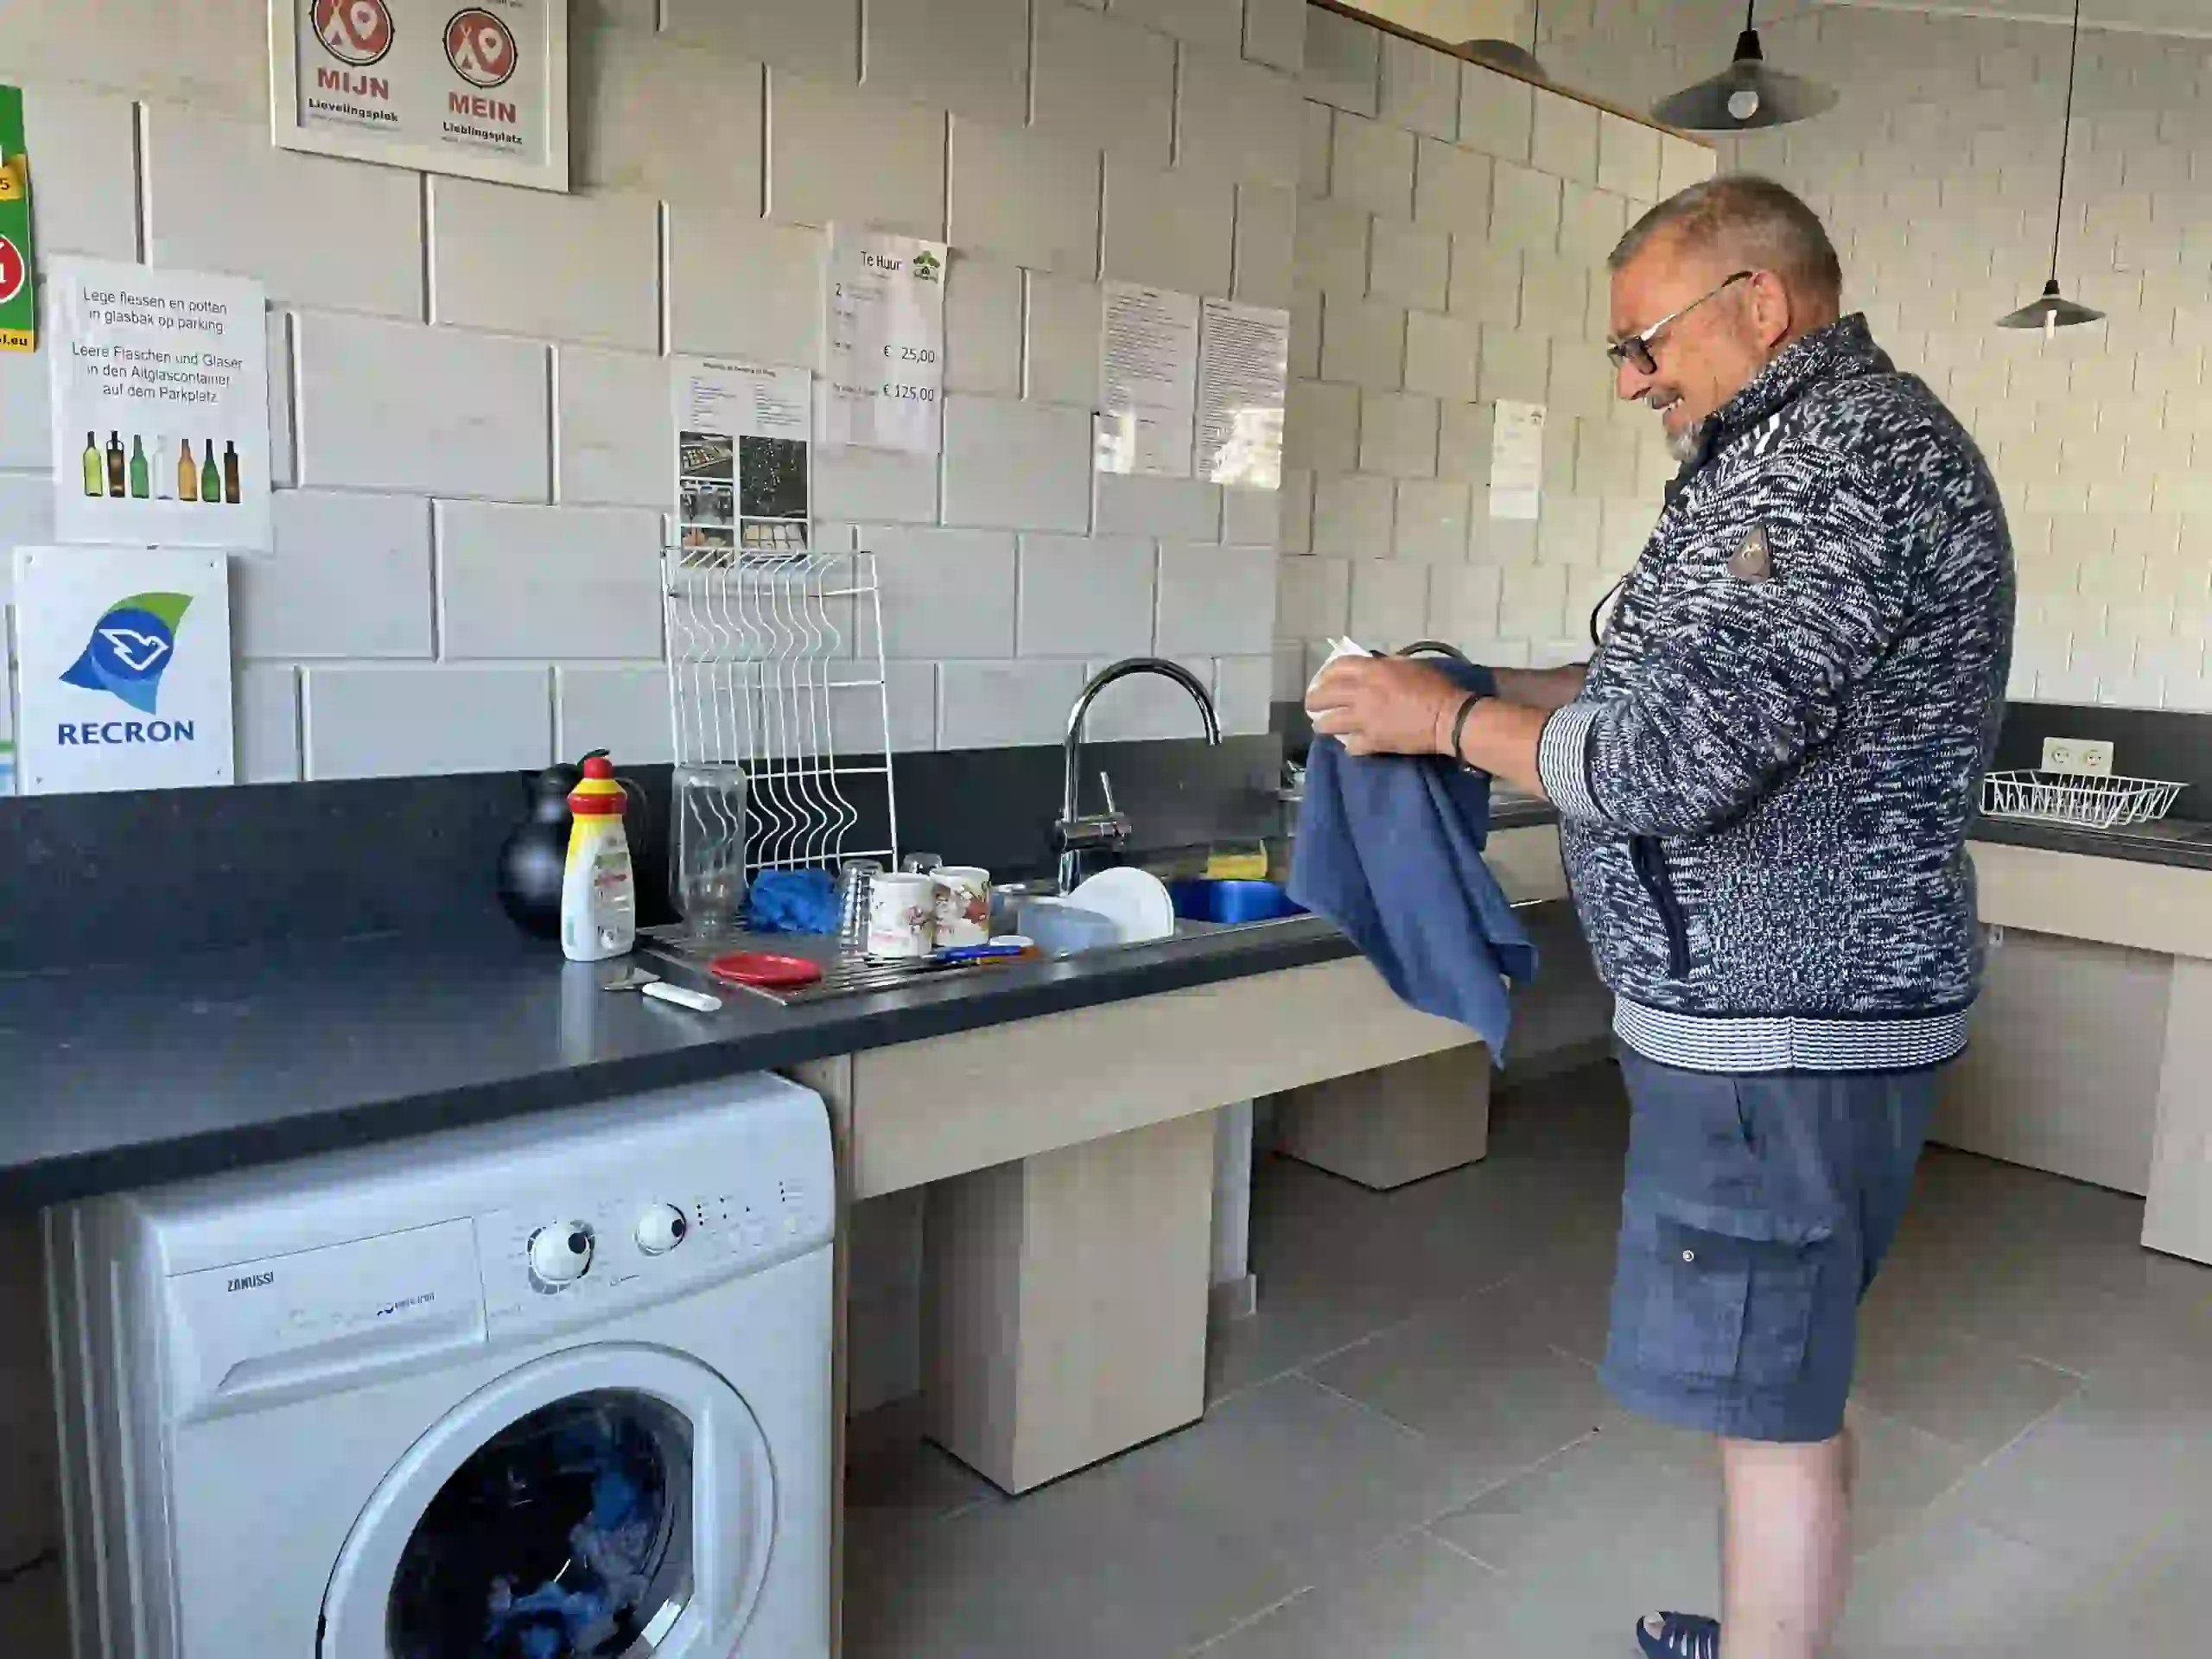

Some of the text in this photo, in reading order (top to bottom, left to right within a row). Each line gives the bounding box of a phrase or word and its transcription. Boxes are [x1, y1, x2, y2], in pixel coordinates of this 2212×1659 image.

[317, 67, 389, 100] MIJN
[308, 98, 398, 122] Lievelingsplek
[448, 91, 517, 124] MEIN
[442, 120, 523, 145] Lieblingsplatz
[861, 251, 900, 270] Te Huur
[83, 286, 227, 315] Lege flessen en potten
[89, 308, 224, 335] in glasbak op parking
[72, 341, 110, 358] Leere
[113, 346, 172, 364] Flaschen
[175, 352, 198, 365] und
[901, 346, 935, 363] 25,00
[86, 364, 231, 388] in den Altglascontainer
[103, 383, 218, 405] auf dem Parkplatz
[894, 384, 934, 403] 125,00
[58, 720, 194, 746] RECRON
[227, 1270, 274, 1293] ZANUSSI
